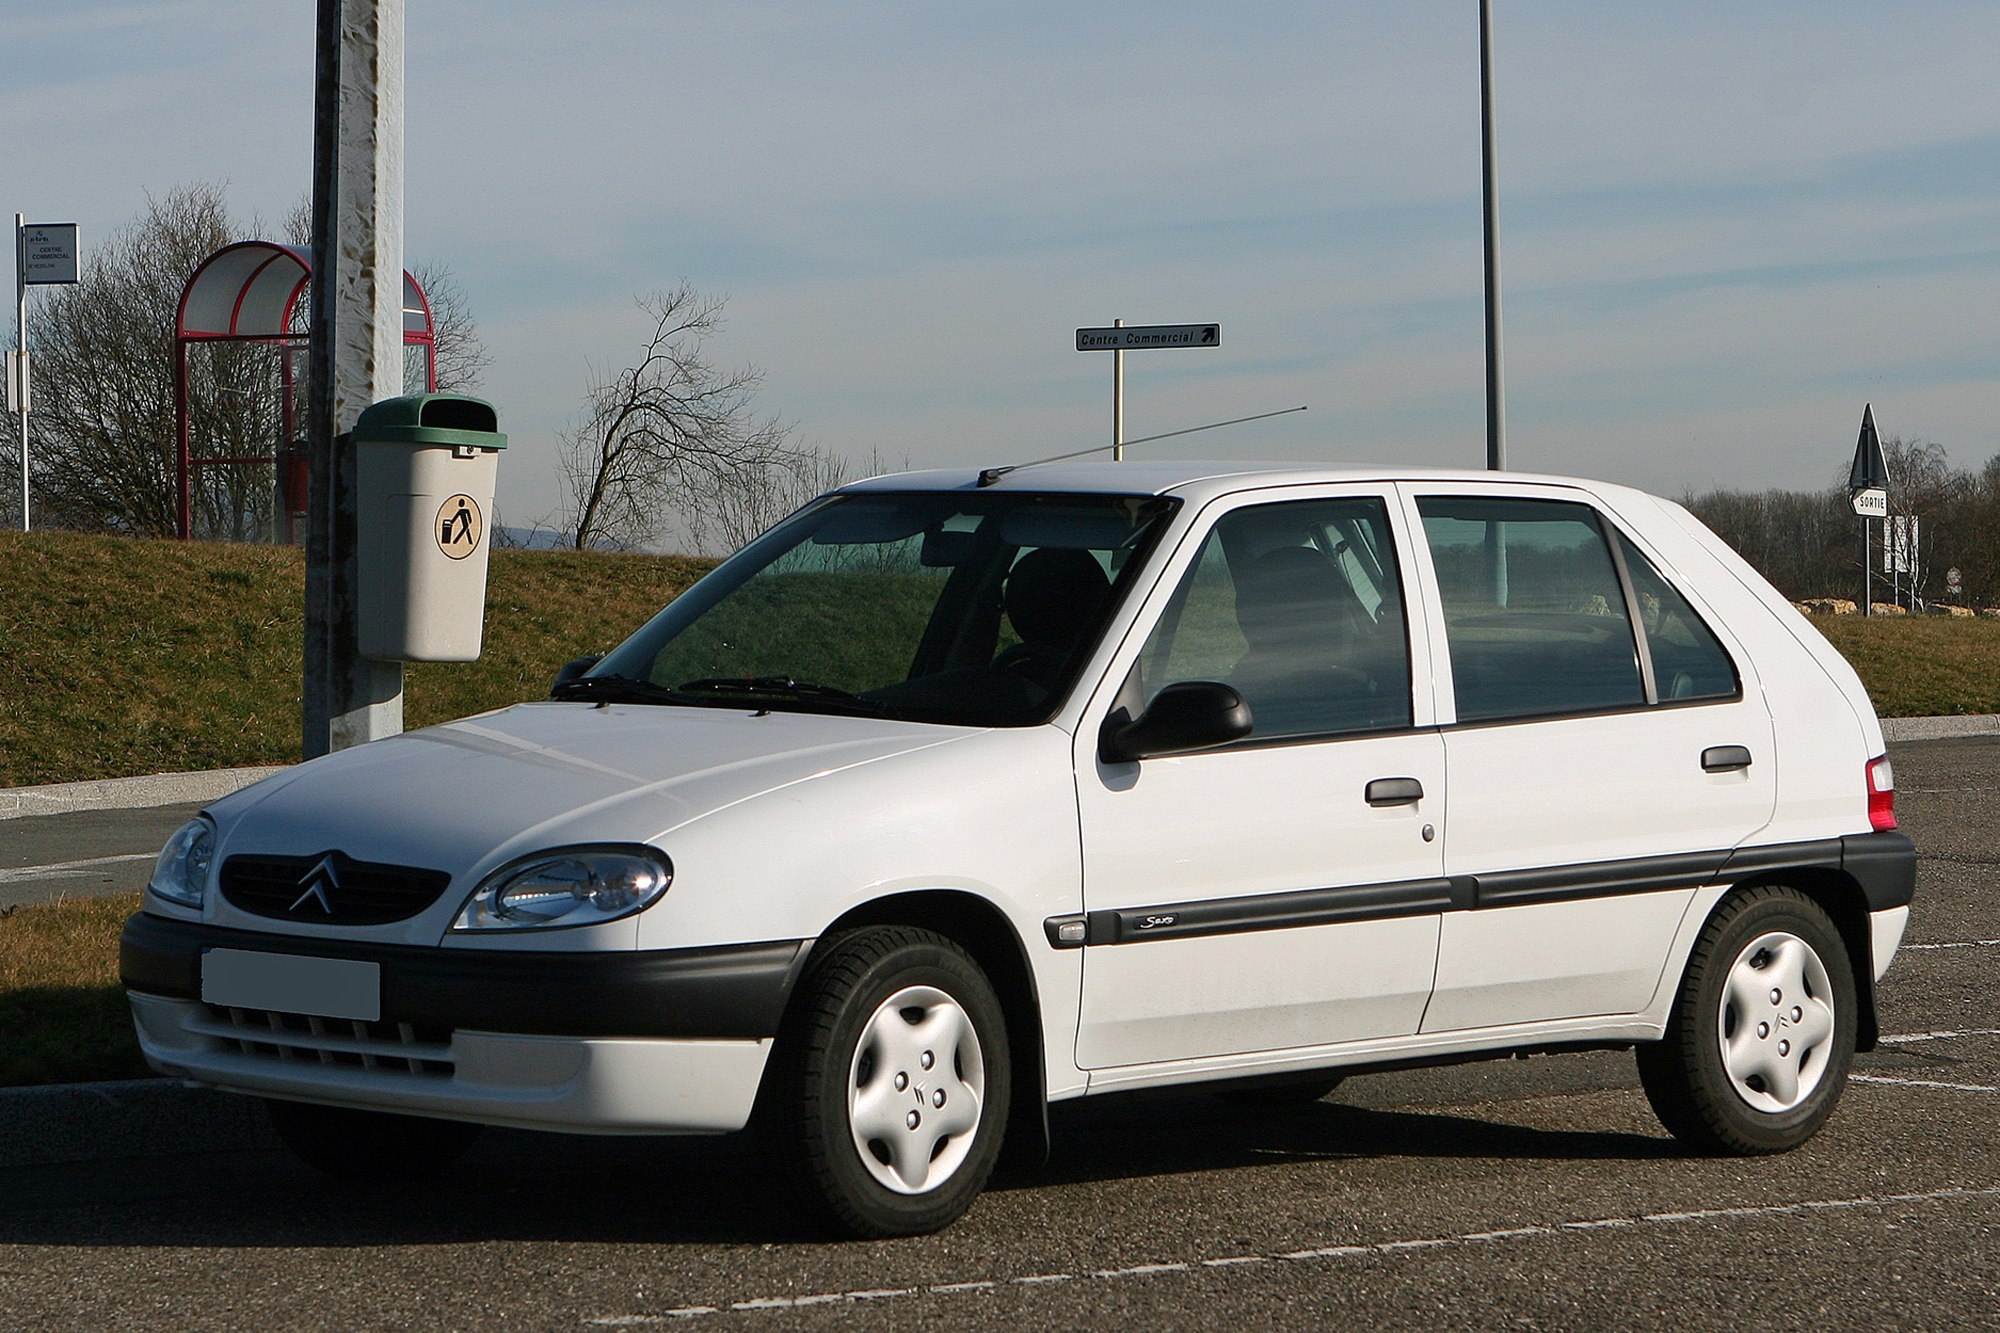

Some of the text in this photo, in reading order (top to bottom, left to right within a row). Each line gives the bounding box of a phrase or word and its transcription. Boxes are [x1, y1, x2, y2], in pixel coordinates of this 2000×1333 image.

[1081, 331, 1195, 346] Centre Commercial
[1859, 496, 1885, 510] SORTIE
